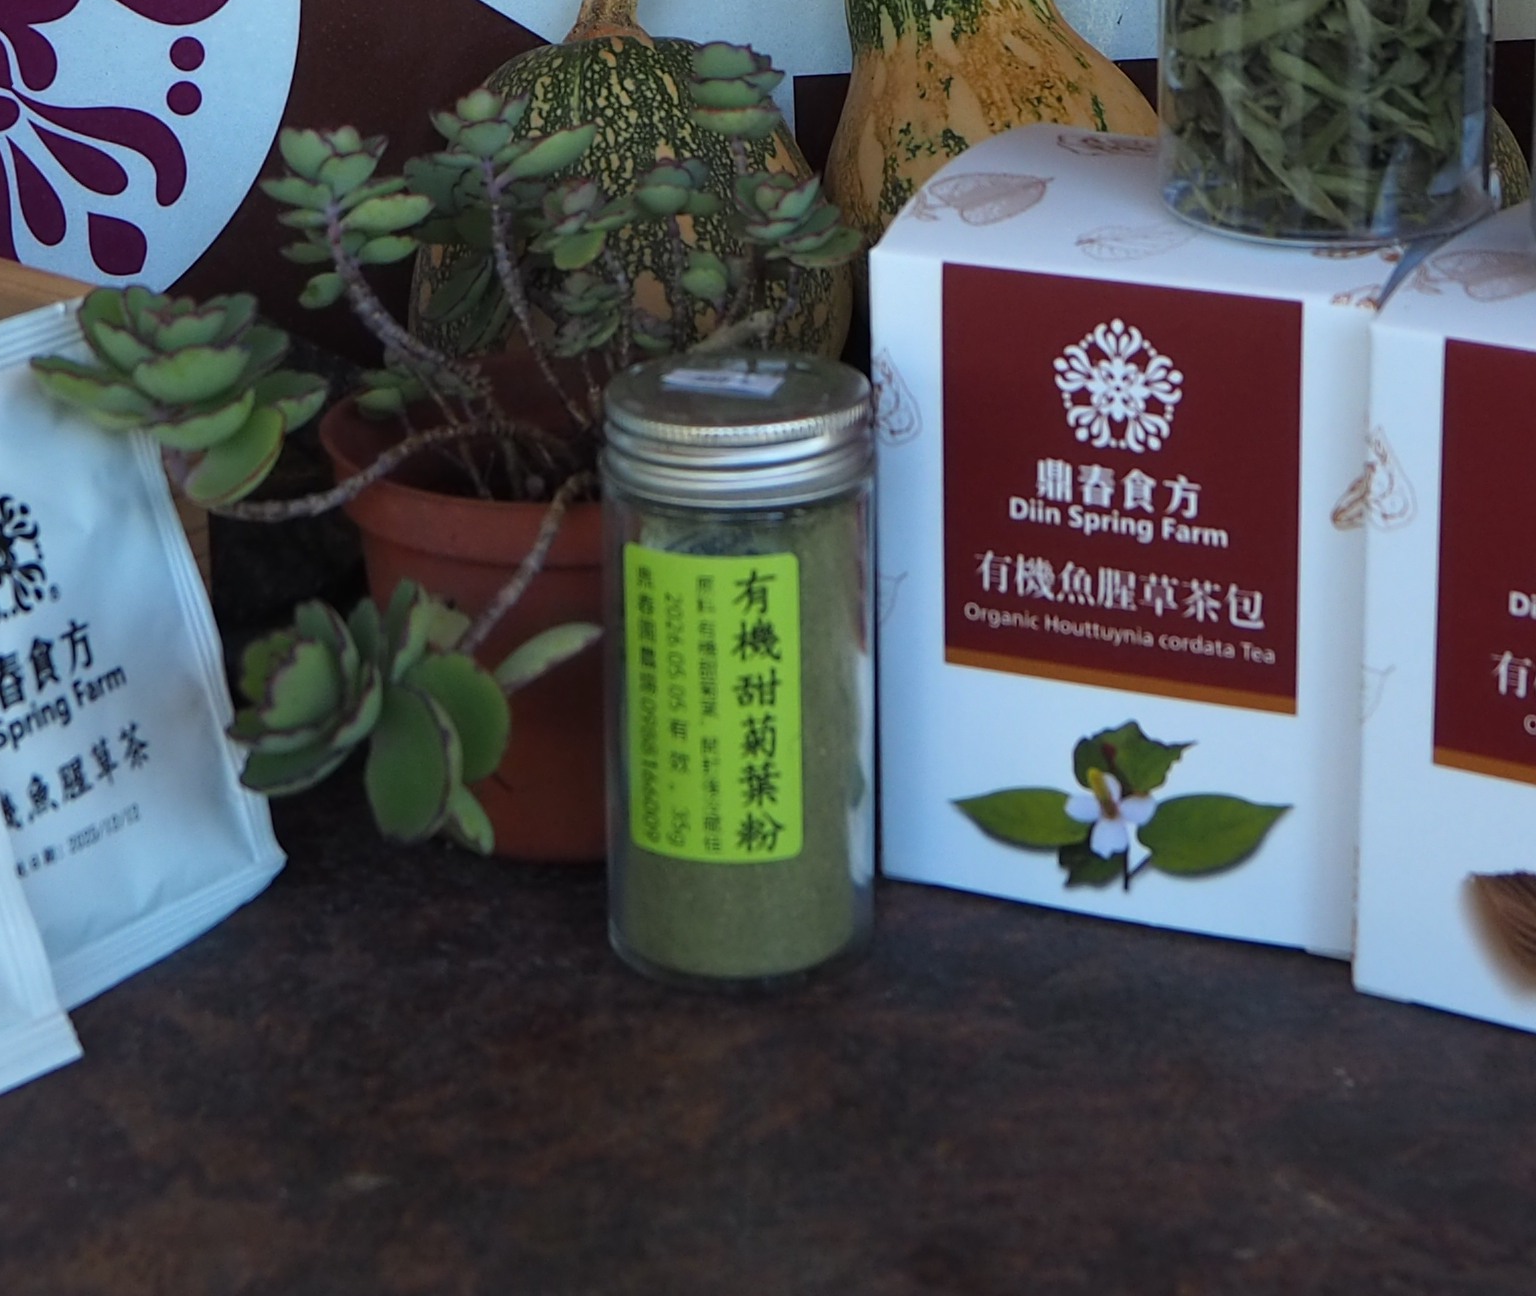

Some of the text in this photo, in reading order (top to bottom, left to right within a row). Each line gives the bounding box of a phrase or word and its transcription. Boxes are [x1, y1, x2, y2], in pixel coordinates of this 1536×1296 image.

[1036, 457, 1202, 519] 鼎春食方
[1009, 496, 1229, 548] Diin Spring Farm
[975, 550, 1265, 629] 有機魚腥草茶包
[964, 602, 1276, 665] Organic Houttuynia cordata Tea
[72, 664, 128, 710] Farm
[732, 568, 785, 852] 有機甜菊葉粉
